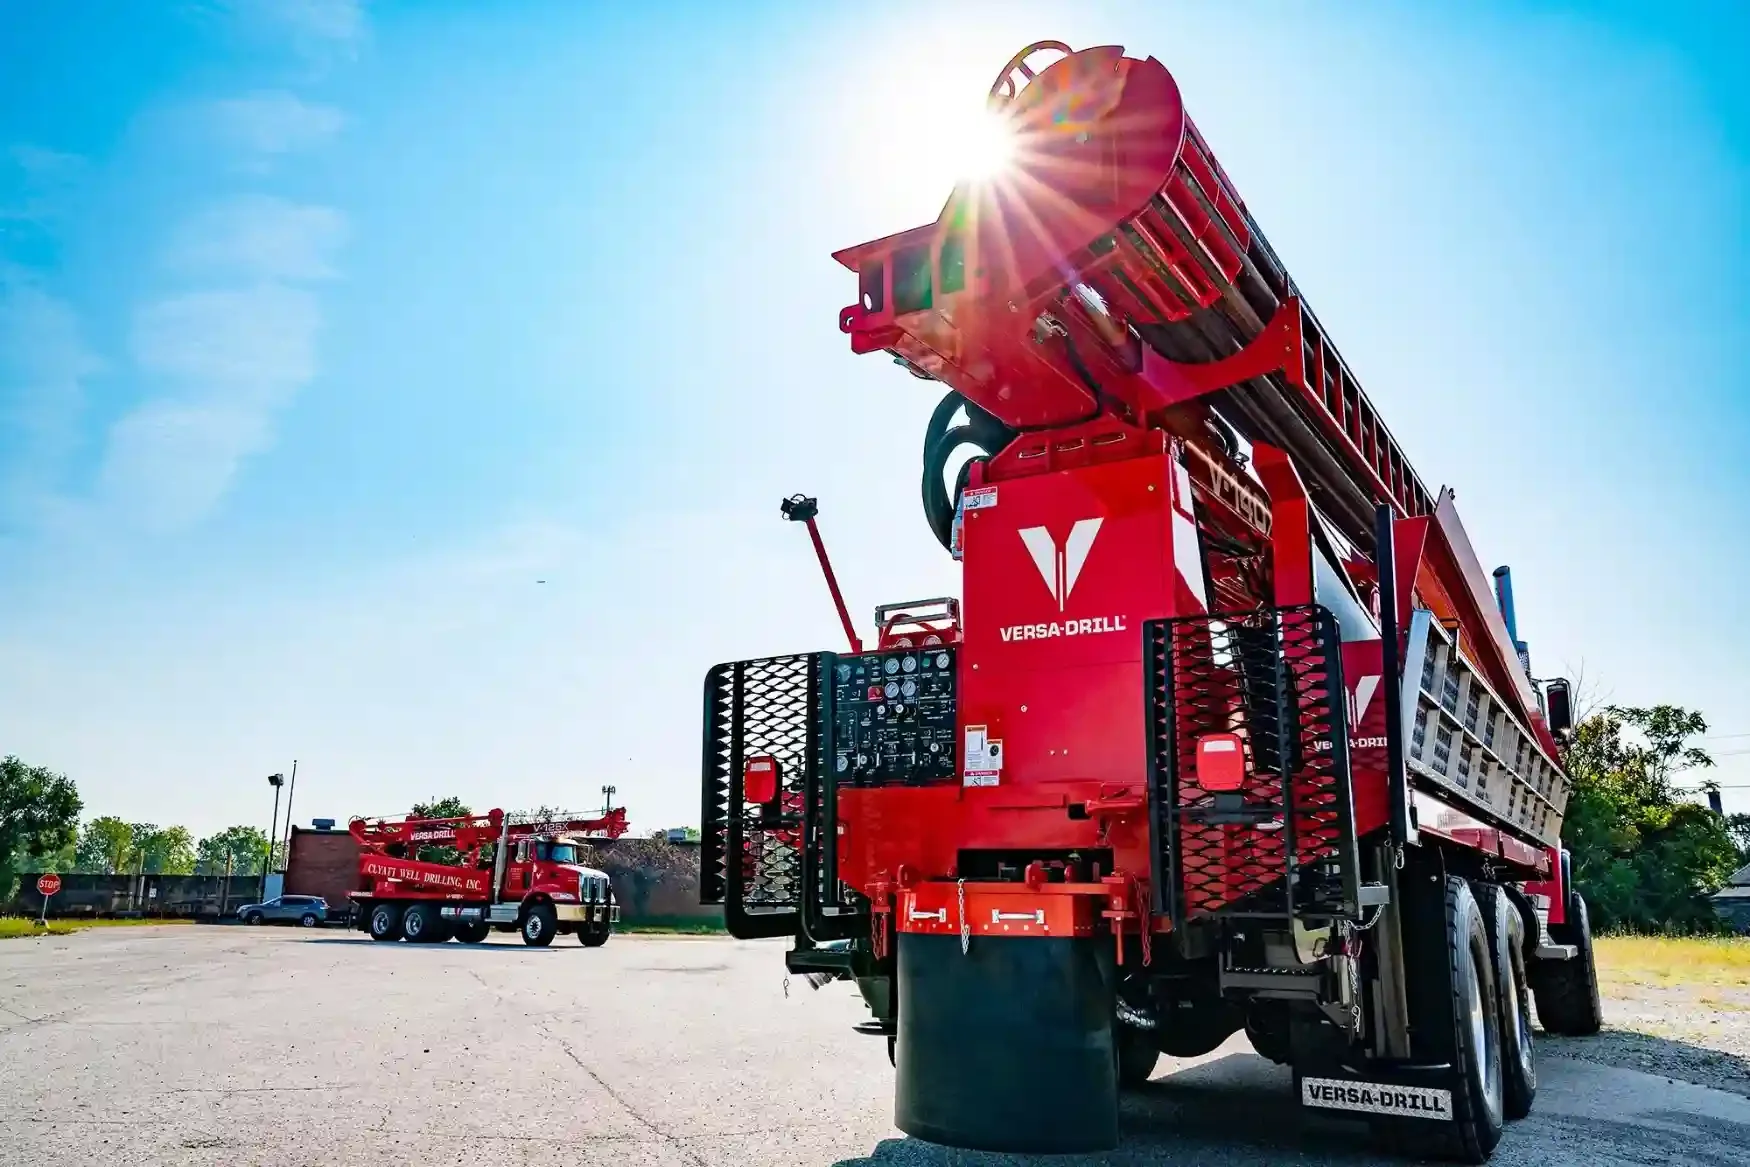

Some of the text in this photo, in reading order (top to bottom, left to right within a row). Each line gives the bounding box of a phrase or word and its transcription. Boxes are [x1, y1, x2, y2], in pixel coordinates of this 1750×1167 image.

[1000, 615, 1126, 641] VERSA-DRILL
[39, 879, 60, 889] STOP
[400, 868, 420, 881] WELL
[424, 872, 463, 888] DRILLING,
[466, 879, 482, 890] INC.
[1308, 1084, 1446, 1113] VERSA-DRILL
